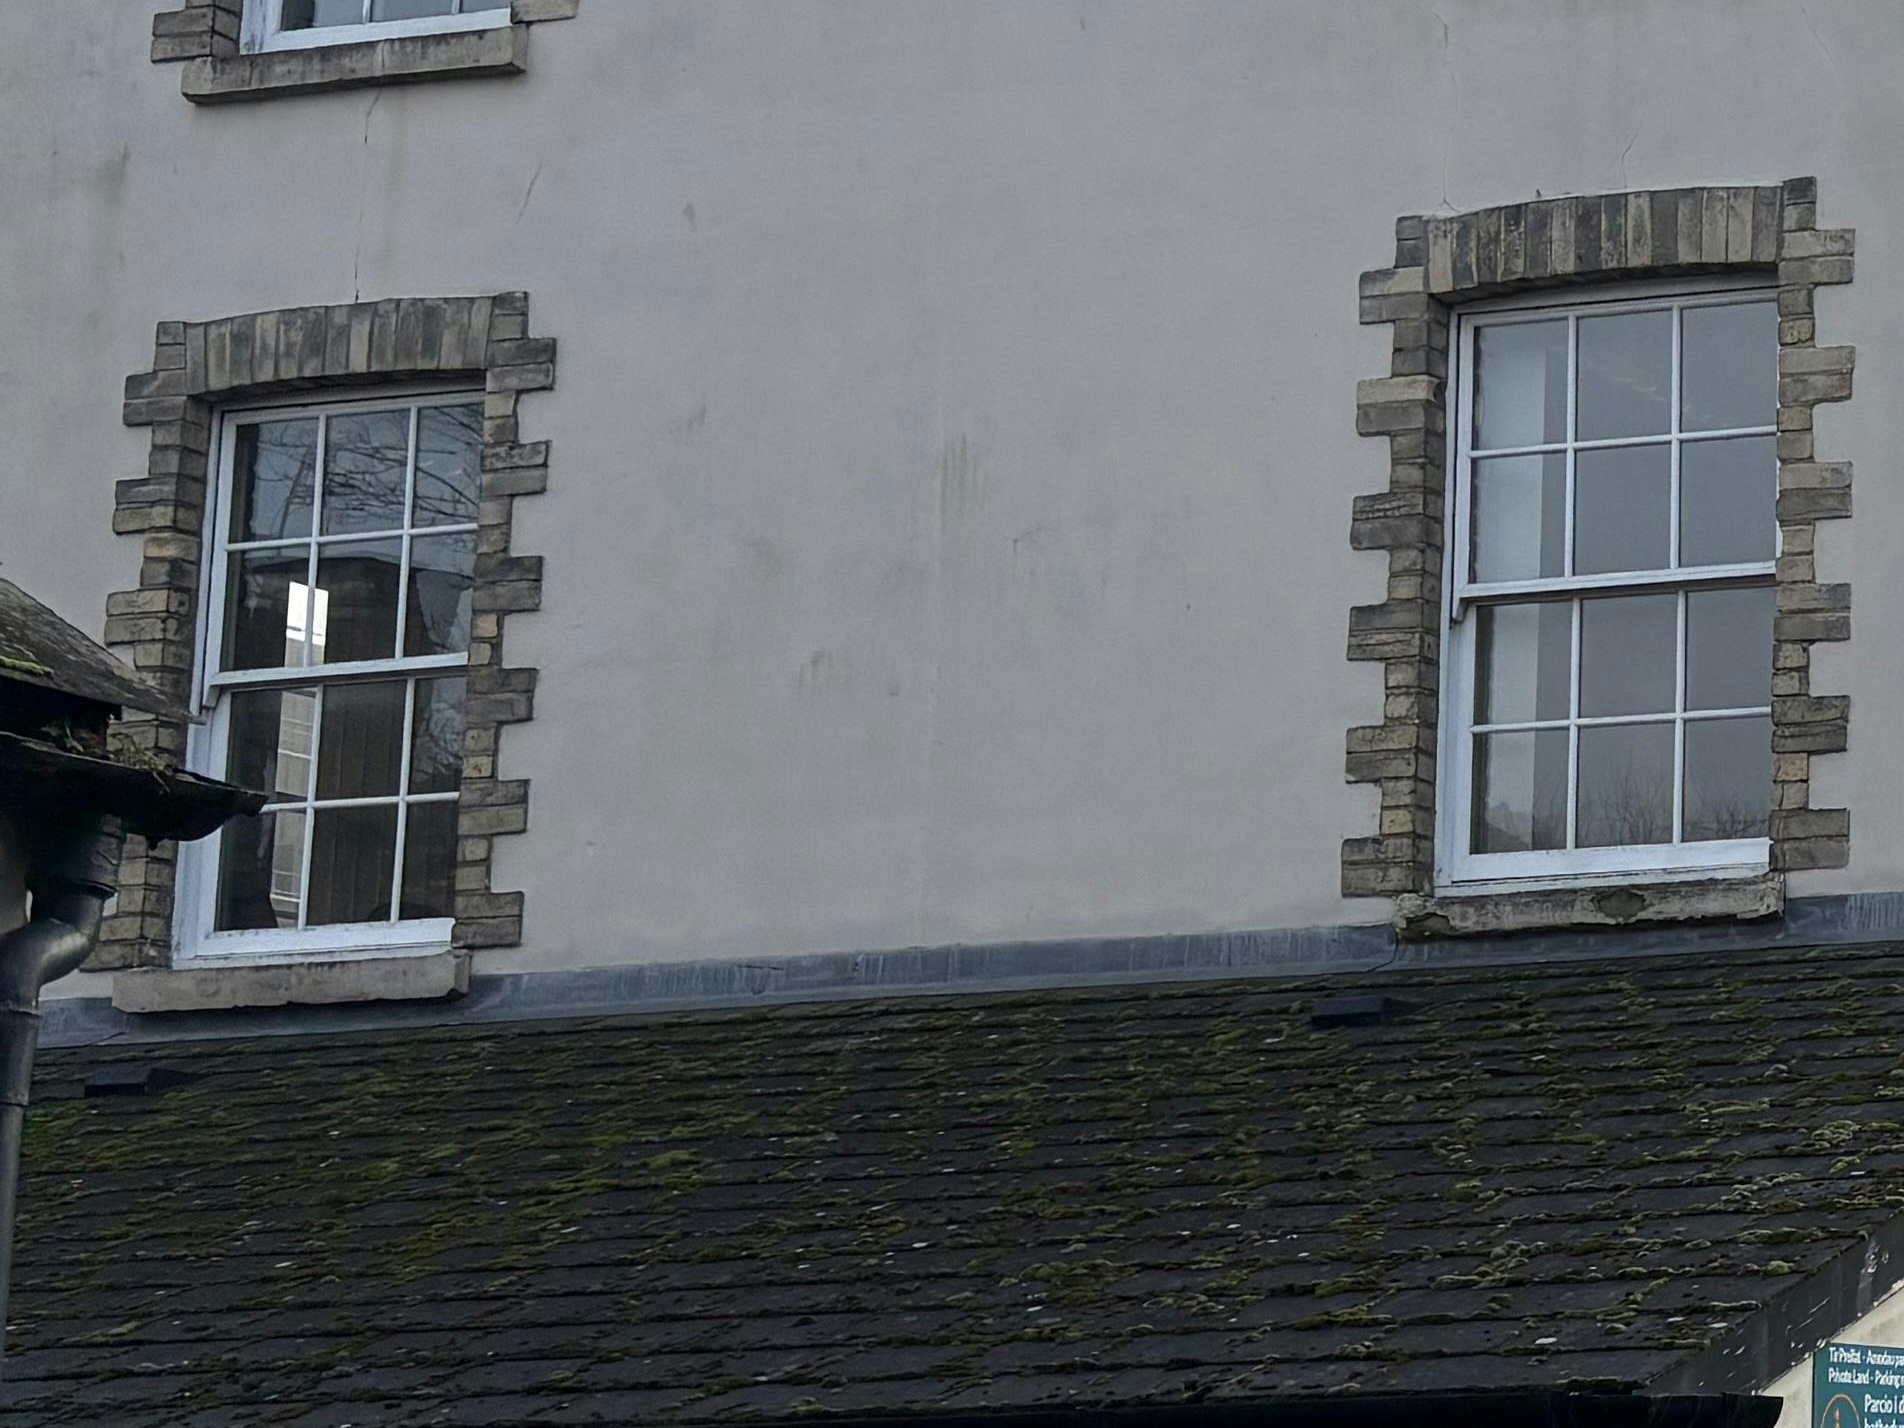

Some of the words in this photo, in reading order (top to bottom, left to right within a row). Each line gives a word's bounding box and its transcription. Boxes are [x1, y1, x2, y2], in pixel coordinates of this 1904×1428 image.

[1853, 1369, 1870, 1385] Land
[1875, 1370, 1900, 1389] Parking
[1864, 1394, 1893, 1413] Parcio
